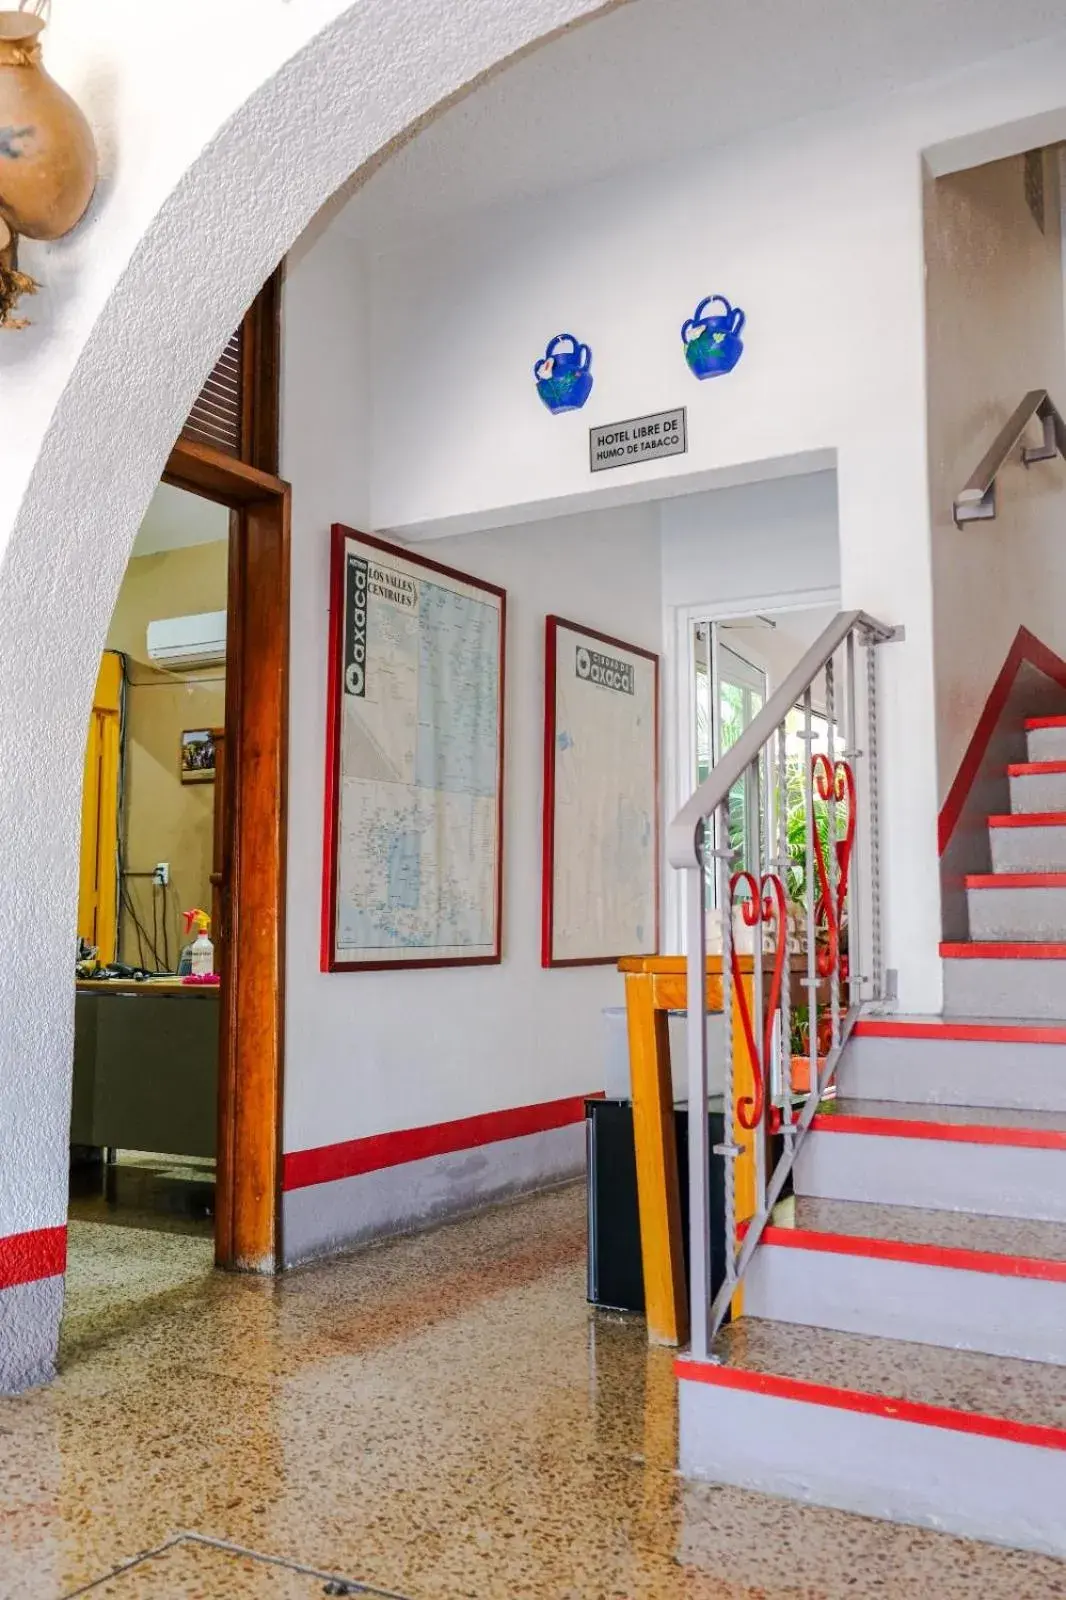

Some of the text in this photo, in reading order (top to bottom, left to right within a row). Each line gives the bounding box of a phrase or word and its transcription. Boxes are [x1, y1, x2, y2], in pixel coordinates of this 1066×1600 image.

[597, 419, 678, 447] HOTEL LIBRE DE
[597, 435, 679, 460] HUMO DE TABACO
[369, 568, 412, 592] LOS VALLES
[368, 582, 411, 606] CENTRALES
[346, 570, 366, 694] Oaxaca
[577, 648, 629, 692] Oaxaca
